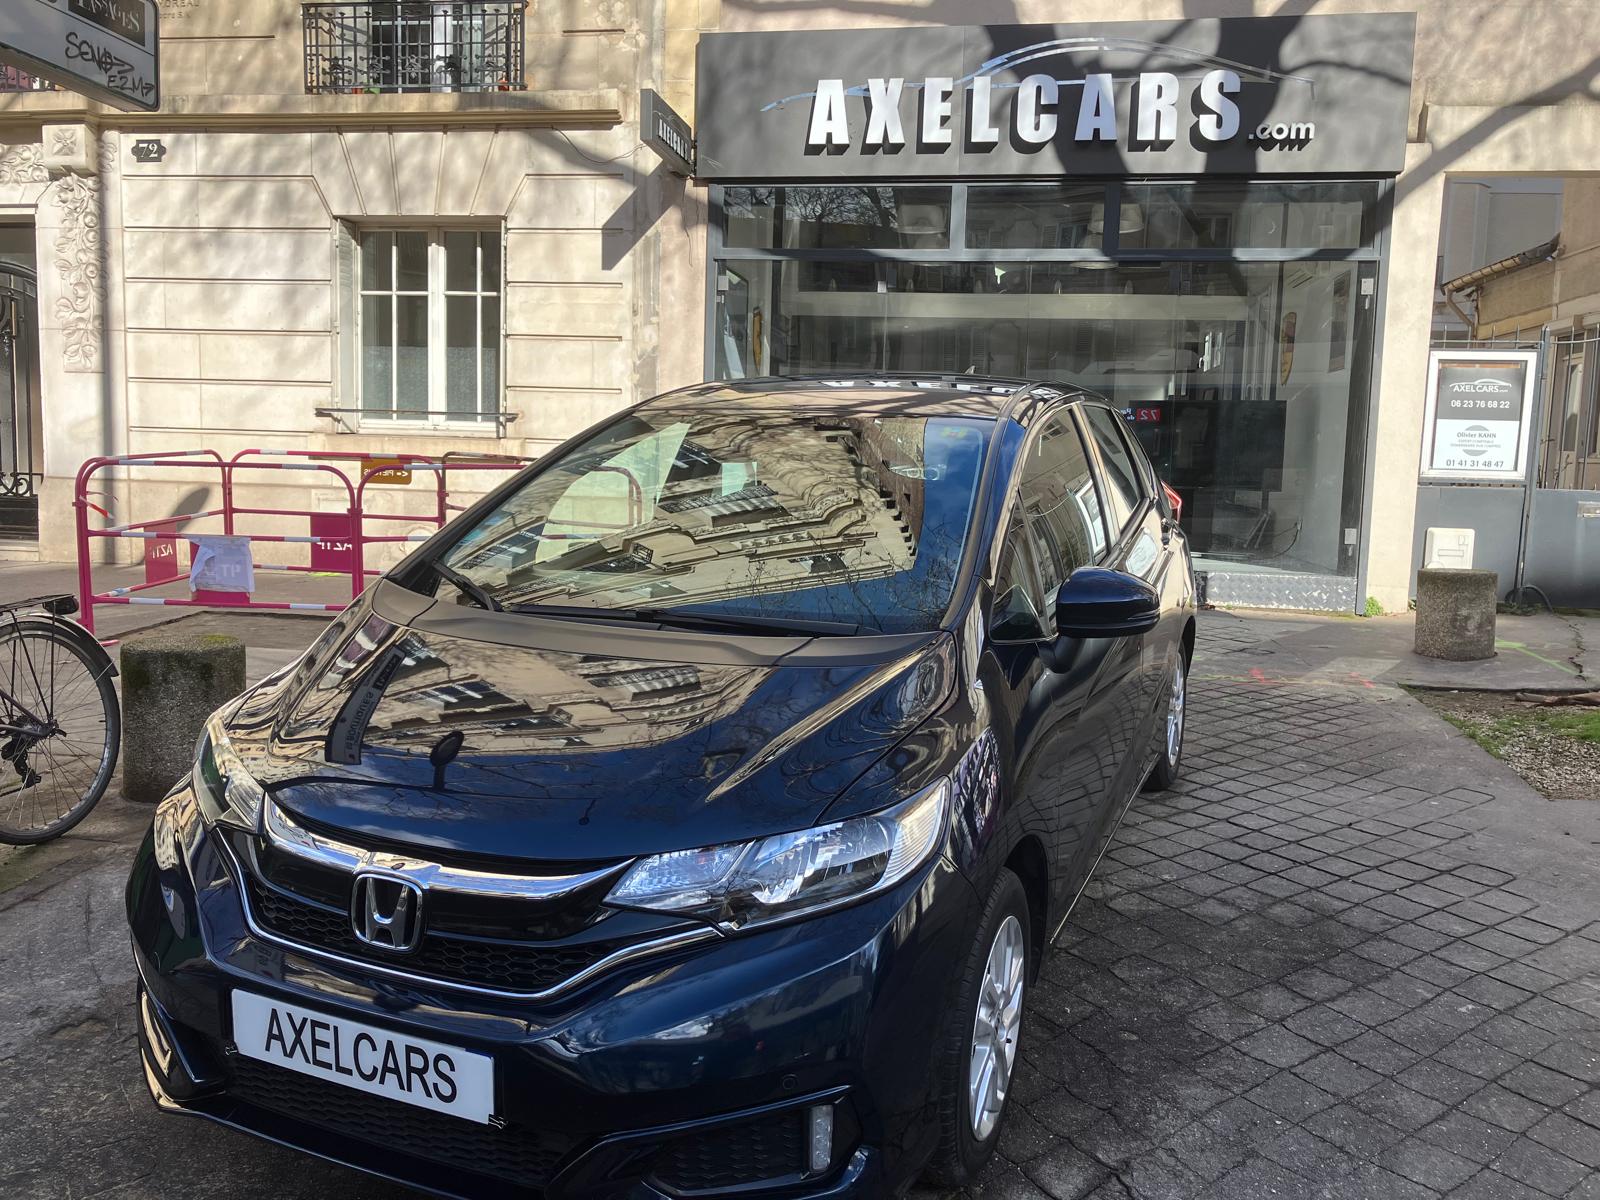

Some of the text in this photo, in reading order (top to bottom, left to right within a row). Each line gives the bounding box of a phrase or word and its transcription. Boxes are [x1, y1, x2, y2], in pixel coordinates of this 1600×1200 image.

[138, 143, 158, 158] 72
[1453, 384, 1499, 393] AXELCARS
[1451, 400, 1461, 408] 06
[1463, 400, 1473, 408] 23
[1500, 401, 1510, 409] 22
[1446, 459, 1455, 467] 01
[1458, 459, 1467, 467] 41
[1470, 460, 1479, 468] 31
[1494, 460, 1504, 469] 47
[265, 1008, 458, 1104] AXELCARS
